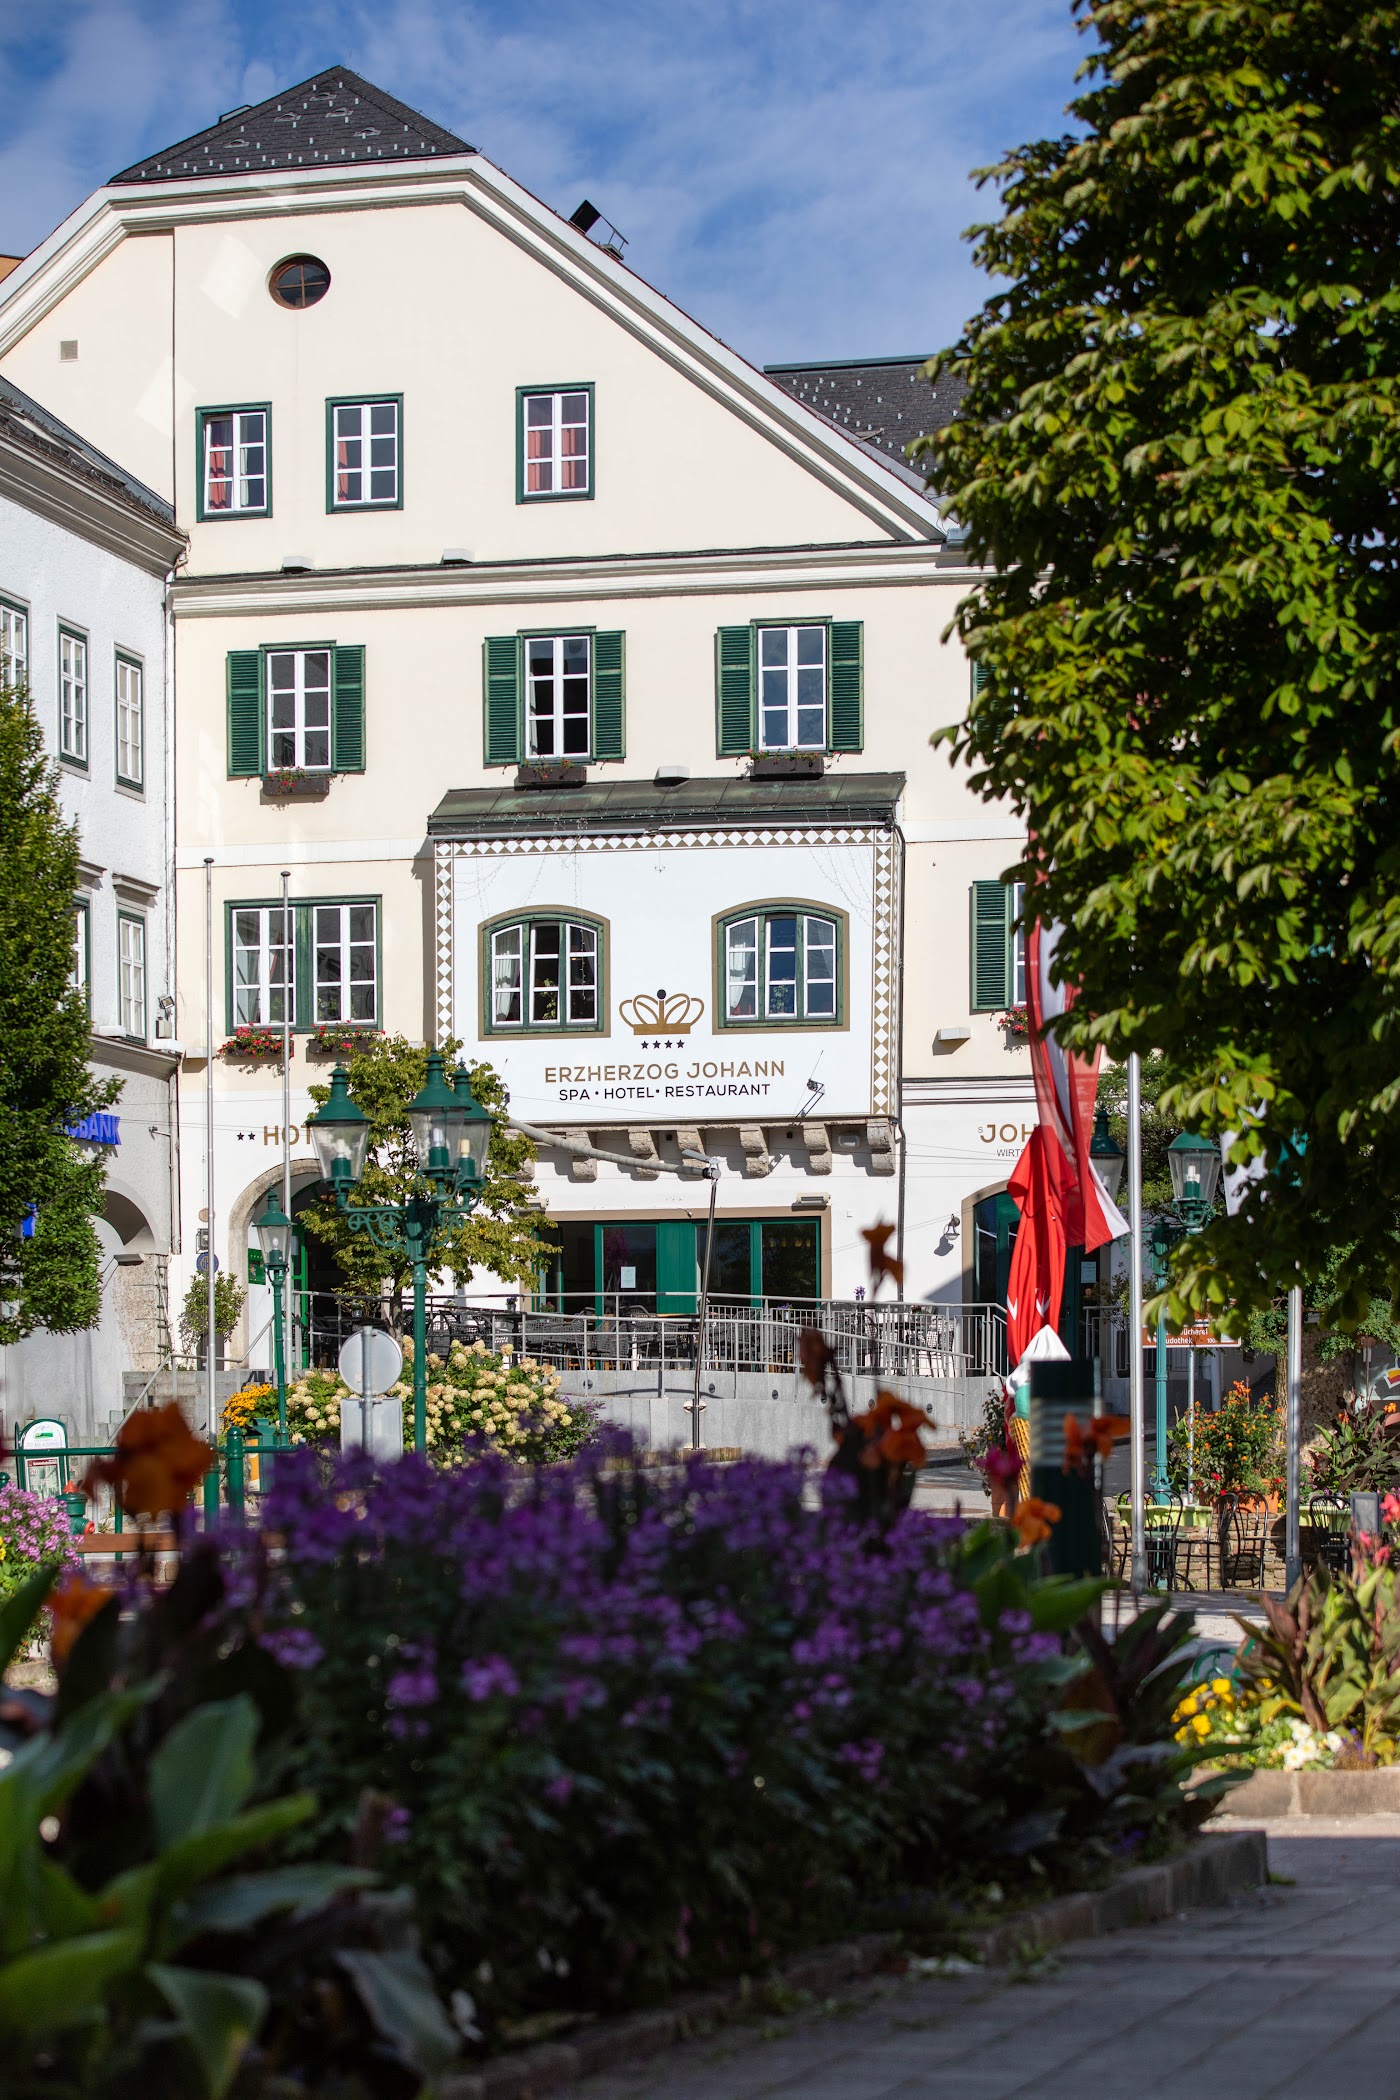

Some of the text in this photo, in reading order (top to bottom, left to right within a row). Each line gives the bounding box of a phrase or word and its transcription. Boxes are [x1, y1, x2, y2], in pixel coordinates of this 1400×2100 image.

[545, 1060, 785, 1083] ERZHERZOG JOHANN
[559, 1083, 771, 1101] SPA HOTEL RESTAURANT
[1181, 1327, 1208, 1336] ücherei
[1165, 1337, 1193, 1345] udothek
